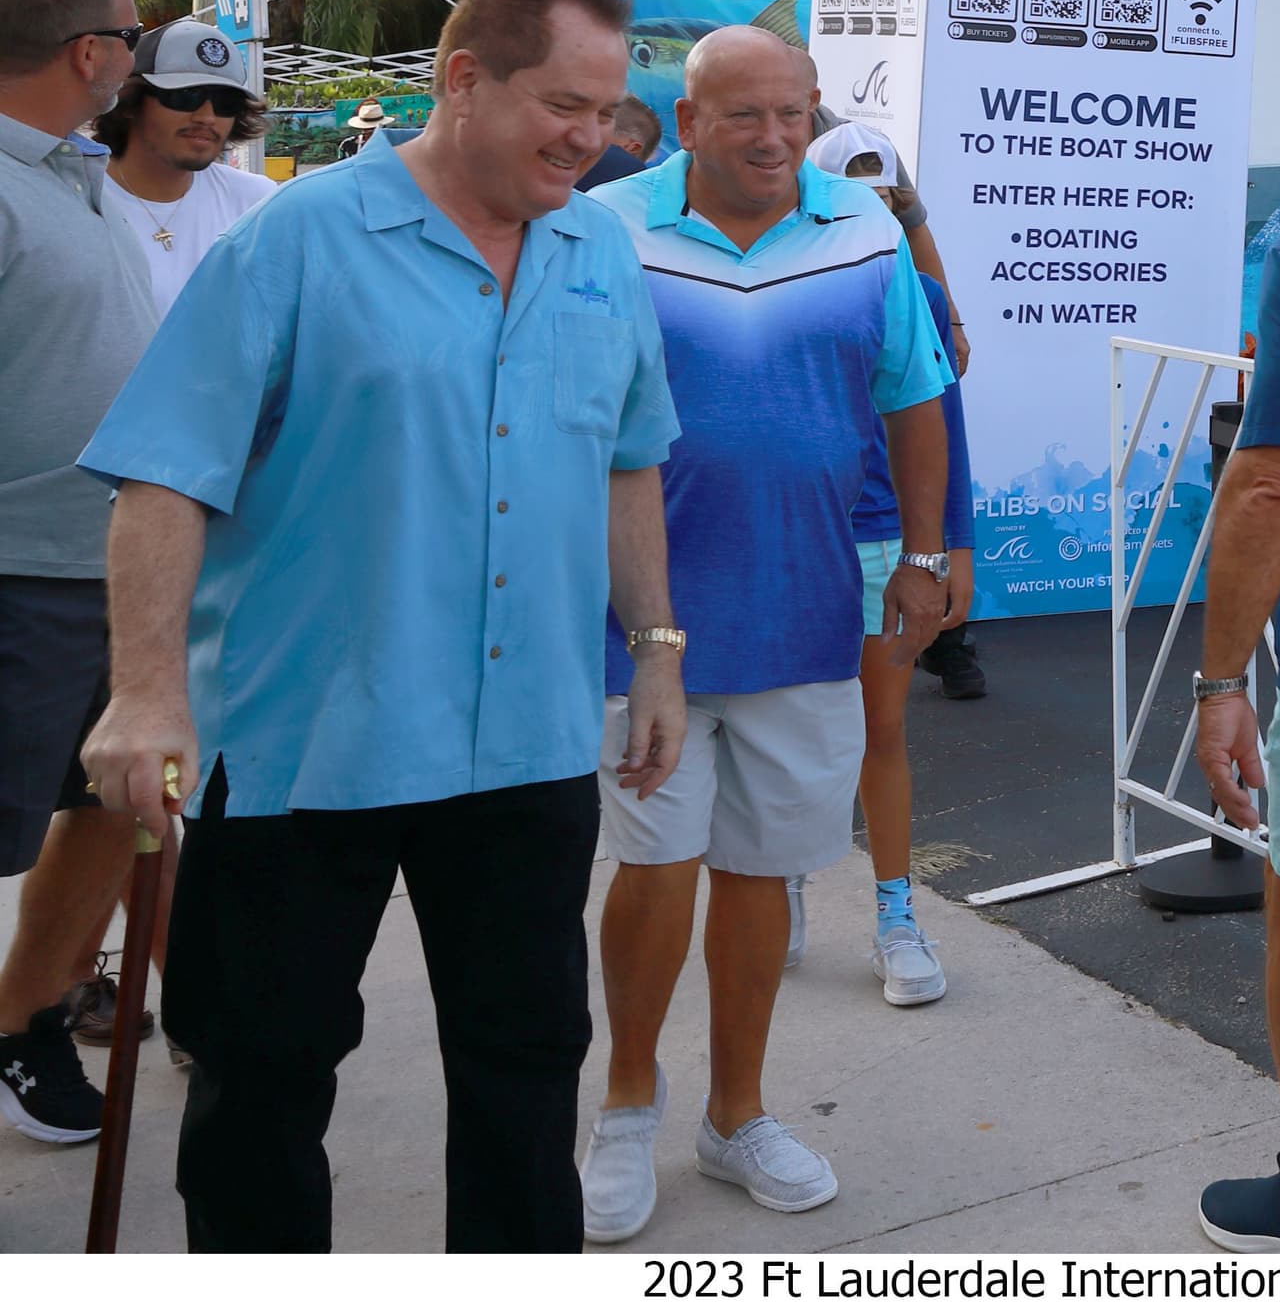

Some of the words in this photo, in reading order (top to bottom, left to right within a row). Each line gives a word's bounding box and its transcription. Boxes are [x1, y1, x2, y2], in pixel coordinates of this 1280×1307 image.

[966, 28, 981, 36] BUY
[982, 29, 1008, 38] TICKETS
[1177, 26, 1205, 35] connect
[1110, 38, 1134, 46] MOBILE
[1135, 39, 1150, 47] APP
[1170, 36, 1228, 48] !FLIBSFREE
[979, 87, 1197, 129] WELCOME
[960, 133, 995, 154] TO
[1003, 134, 1053, 156] THE
[1060, 137, 1128, 159] BOAT
[1134, 140, 1213, 162] SHOW
[973, 184, 1056, 206] ENTER
[1063, 187, 1129, 208] HERE
[1137, 189, 1194, 210] FOR:
[1026, 228, 1138, 250] BOATING
[990, 261, 1167, 282] ACCESSORIES
[1018, 304, 1043, 324] IN
[1051, 304, 1137, 324] WATER
[973, 494, 1040, 519] FLIBS
[1048, 493, 1085, 514] ON
[1092, 490, 1182, 512] SCIAL
[1007, 578, 1055, 593] WATCH
[1058, 576, 1095, 590] YOUR
[1098, 575, 1130, 587] STP
